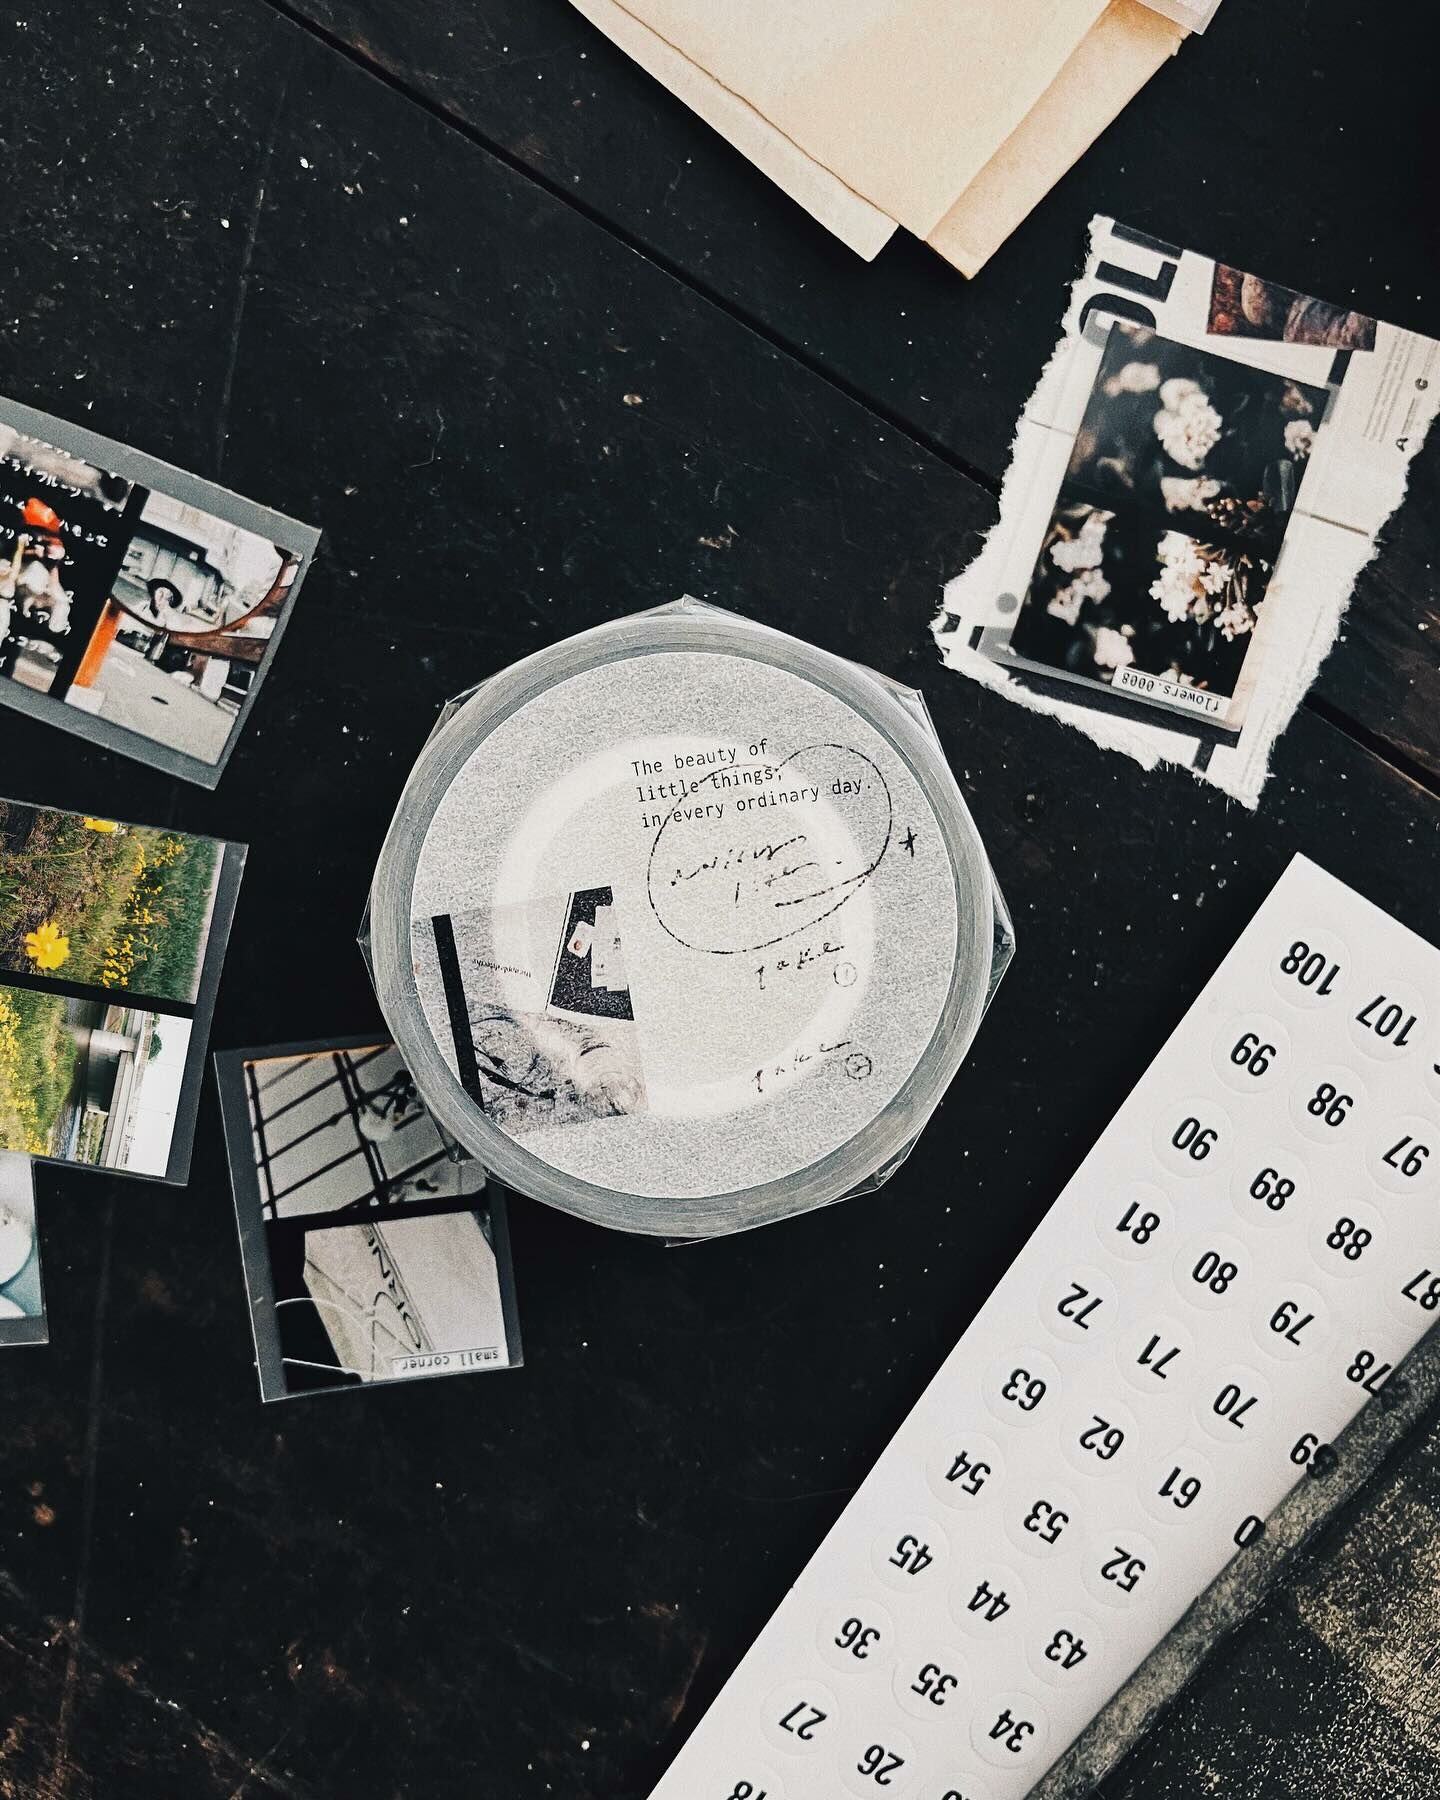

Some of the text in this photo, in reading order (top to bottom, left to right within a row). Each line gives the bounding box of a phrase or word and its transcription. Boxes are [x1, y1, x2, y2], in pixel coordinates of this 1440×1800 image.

[1121, 672, 1219, 712] flowers.0008
[631, 738, 768, 777] The beauty of
[636, 767, 782, 803] little things,
[641, 778, 871, 828] in every ordinary day.
[1280, 942, 1341, 996] 108
[1355, 995, 1417, 1047] 107
[1231, 1033, 1276, 1077] 99
[1308, 1083, 1354, 1127] 98
[1172, 1117, 1218, 1161] 90
[1382, 1135, 1430, 1177] 97
[1250, 1168, 1295, 1211] 89
[1116, 1202, 1161, 1245] 81
[1326, 1217, 1372, 1260] 88
[1192, 1251, 1238, 1294] 80
[1401, 1269, 1440, 1311] 87
[1057, 1282, 1103, 1329] 72
[1269, 1301, 1315, 1346] 79
[402, 1350, 499, 1370] small corner
[1137, 1335, 1181, 1379] 71
[1346, 1350, 1393, 1395] 78
[1001, 1368, 1047, 1411] 63
[1213, 1384, 1258, 1428] 70
[1079, 1415, 1125, 1460] 62
[945, 1451, 991, 1496] 54
[1158, 1467, 1201, 1508] 61
[1023, 1500, 1069, 1545] 53
[888, 1535, 933, 1576] 45
[1100, 1546, 1146, 1593] 52
[967, 1580, 1011, 1623] 44
[834, 1617, 880, 1660] 36
[1044, 1629, 1088, 1670] 43
[911, 1663, 958, 1706] 35
[778, 1701, 827, 1741] 27
[989, 1709, 1035, 1753] 34
[857, 1744, 905, 1786] 26
